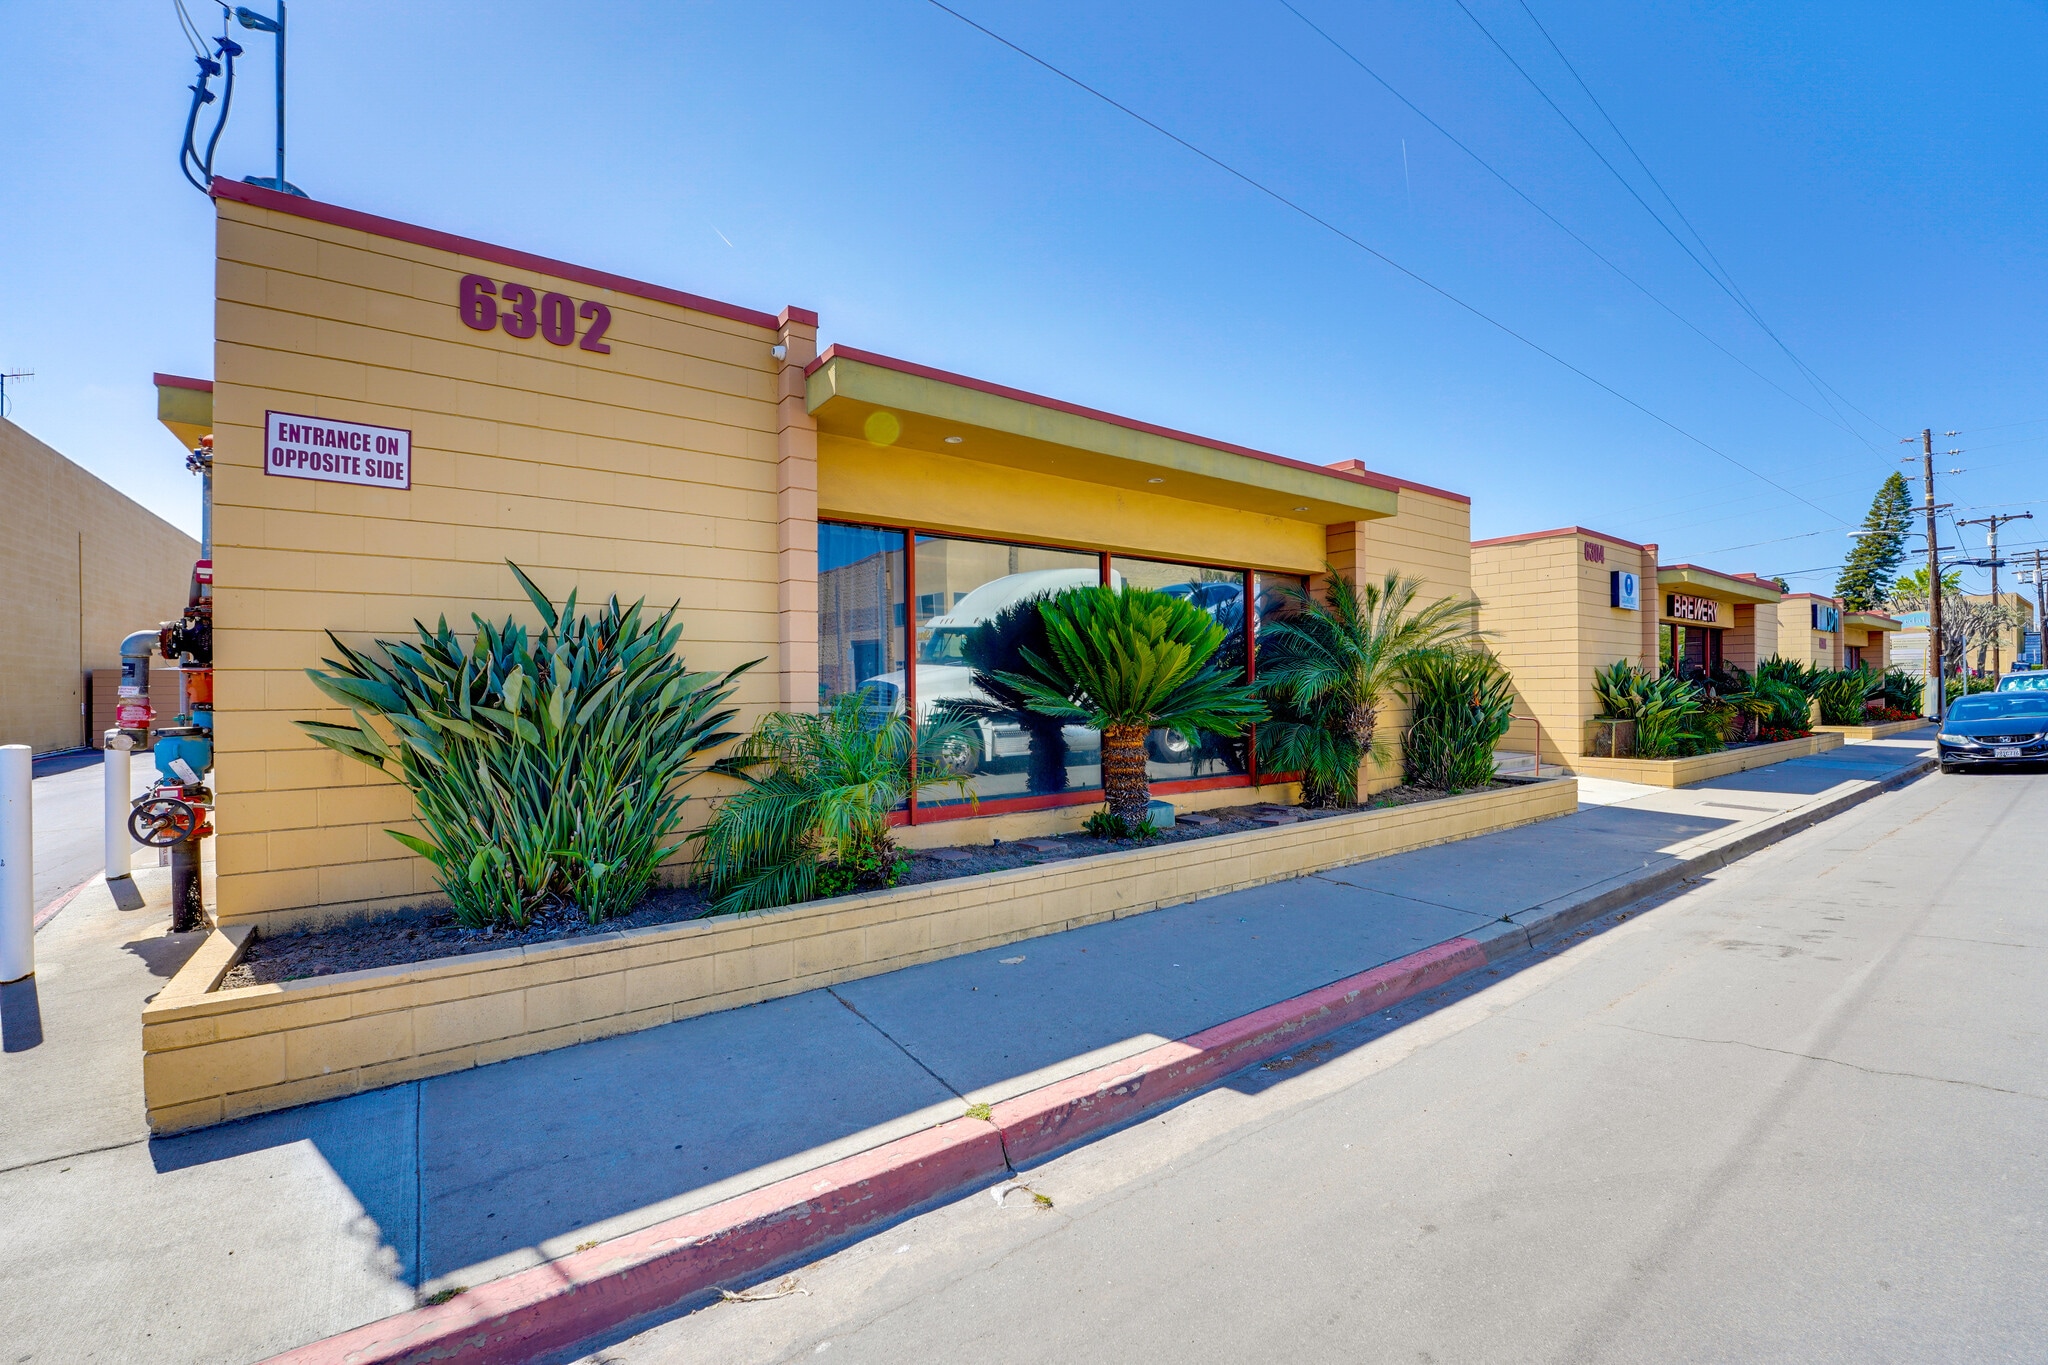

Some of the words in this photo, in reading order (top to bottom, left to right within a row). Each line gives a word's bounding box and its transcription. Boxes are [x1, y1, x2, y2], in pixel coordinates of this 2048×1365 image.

[459, 273, 612, 355] 6302
[278, 422, 371, 453] ENTRANCE
[375, 435, 399, 456] ON
[271, 447, 361, 477] OPPOSITE
[365, 458, 405, 481] SIDE
[1584, 541, 1604, 564] 6304
[1674, 594, 1719, 622] BREWERY
